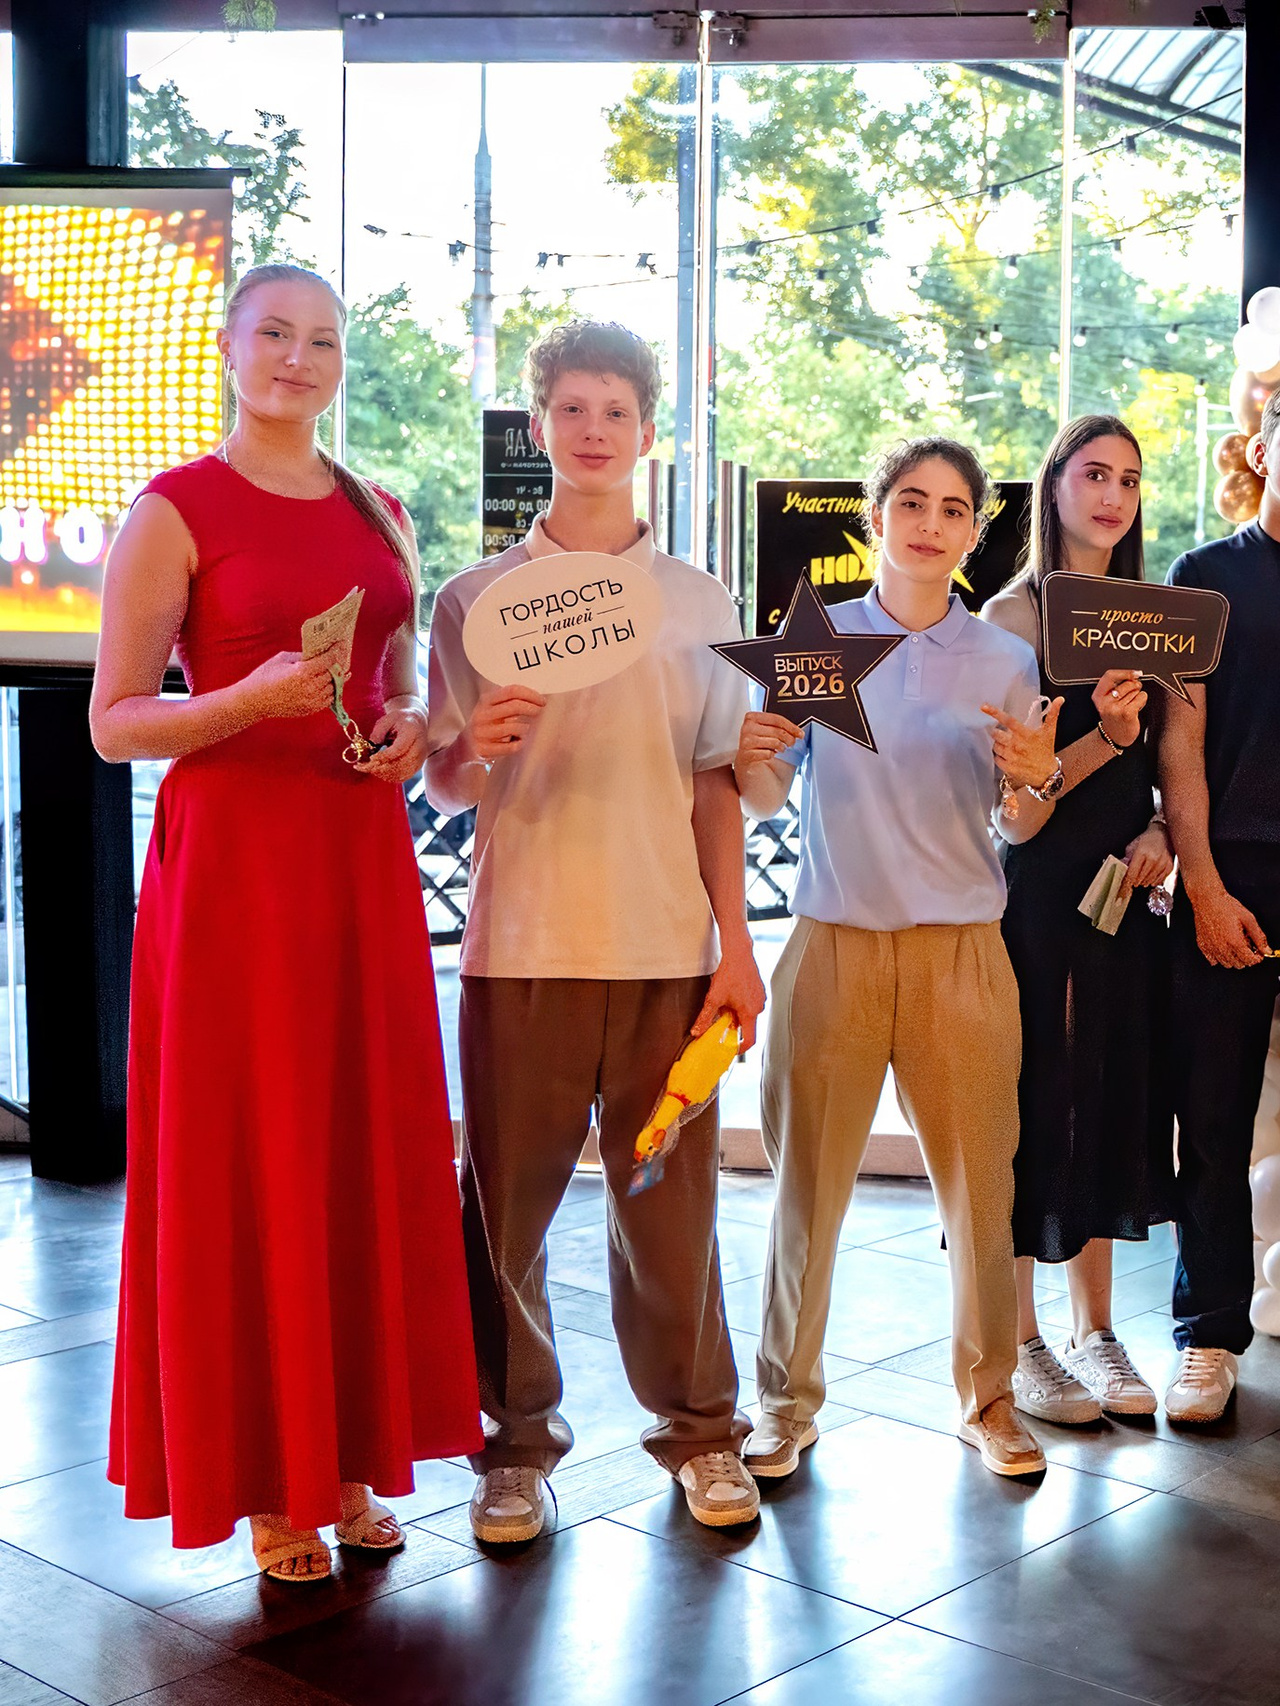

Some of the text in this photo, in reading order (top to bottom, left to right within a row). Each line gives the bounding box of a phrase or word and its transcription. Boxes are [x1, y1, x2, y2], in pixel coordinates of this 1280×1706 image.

[499, 578, 624, 626] ГОРДОСТЬ
[542, 607, 594, 635] нашей
[1100, 609, 1164, 628] просто
[513, 618, 636, 671] ШКОЛЫ
[1072, 627, 1195, 654] КРАСОТКИ
[775, 655, 844, 673] ВЫПУСК
[777, 673, 845, 697] 2026
